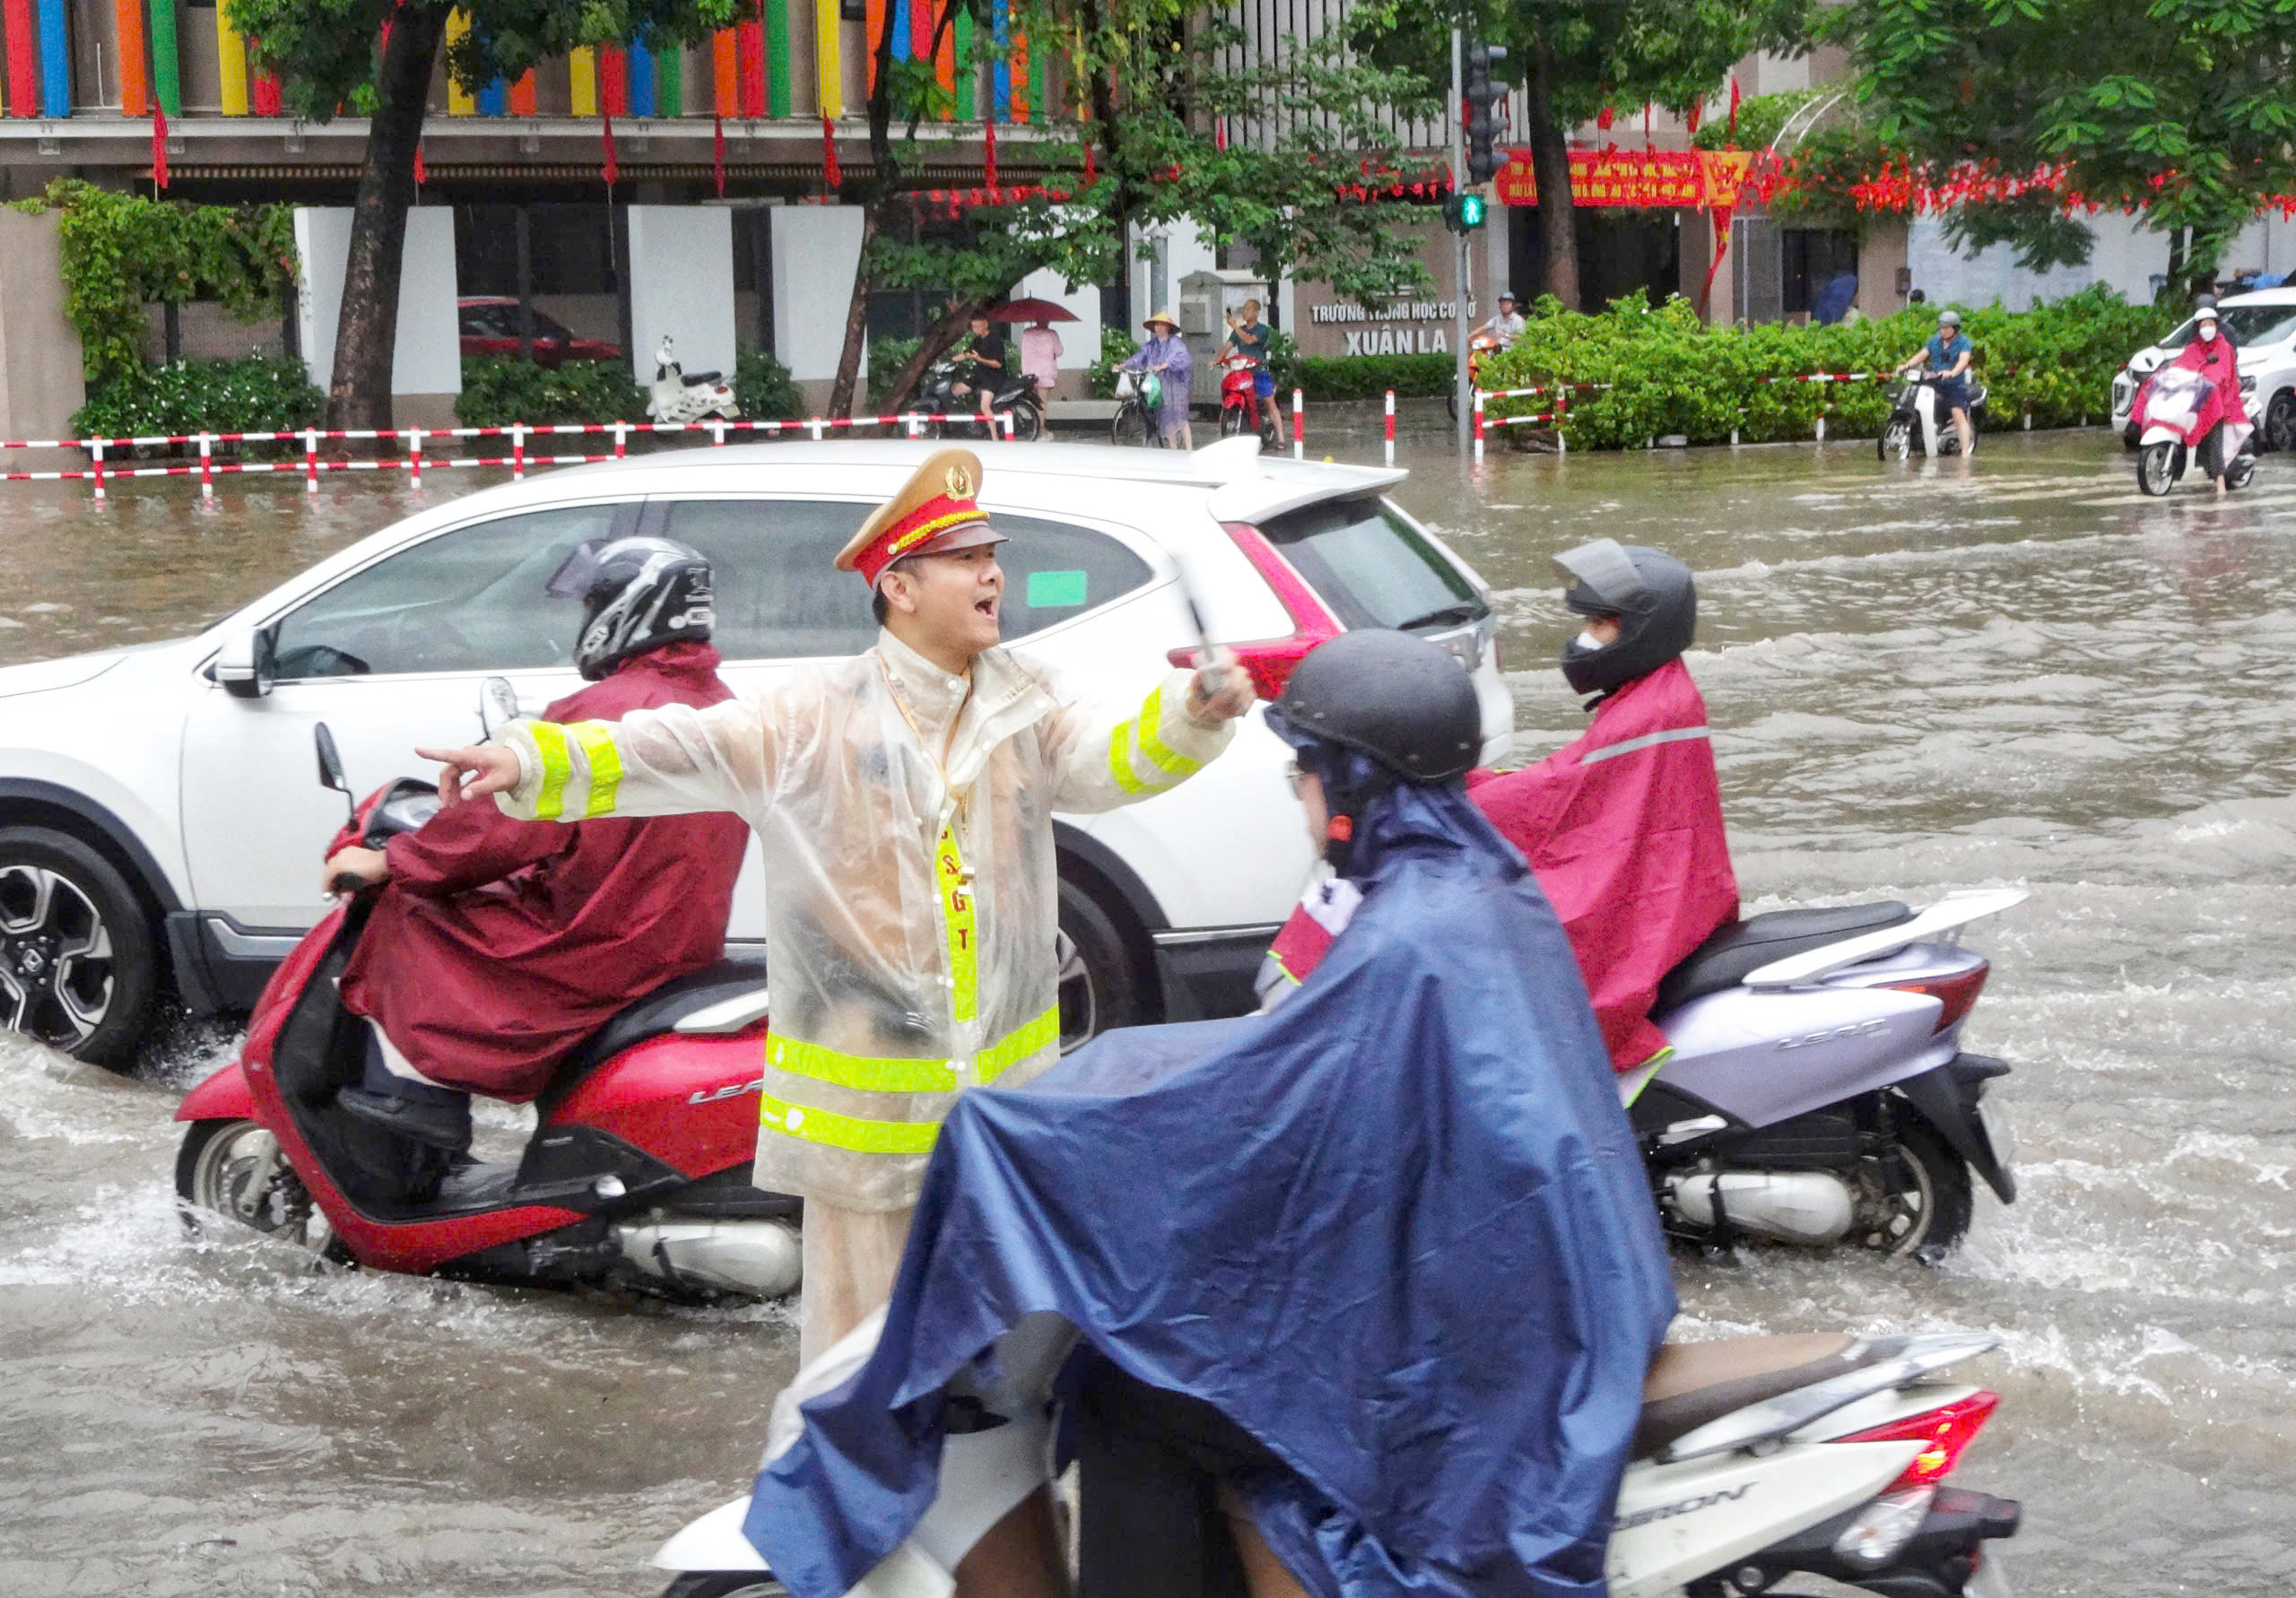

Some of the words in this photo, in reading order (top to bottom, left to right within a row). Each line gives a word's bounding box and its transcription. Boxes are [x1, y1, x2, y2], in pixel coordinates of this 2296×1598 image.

[1413, 301, 1437, 324] HỌC
[1346, 325, 1413, 356] XUÂN
[1419, 328, 1447, 354] LA
[689, 1079, 764, 1104] LEA
